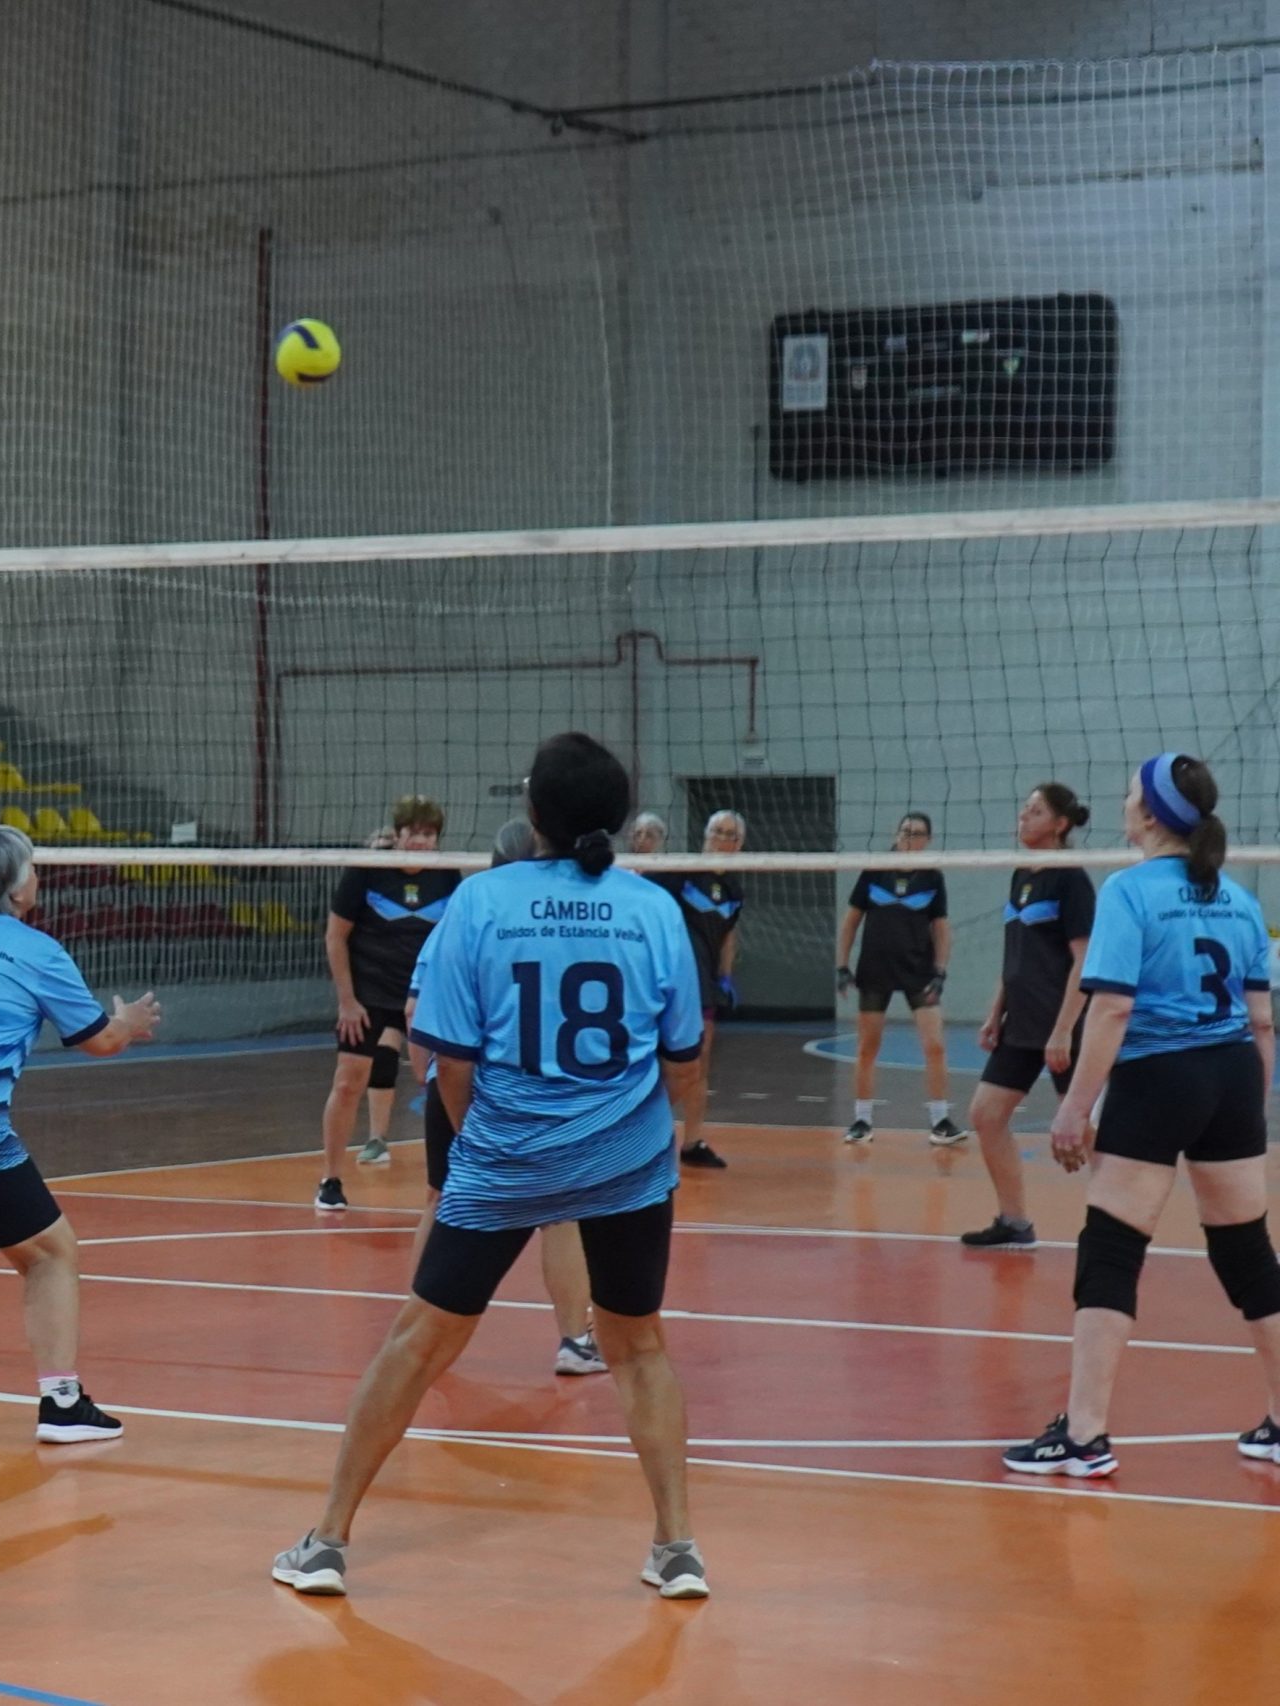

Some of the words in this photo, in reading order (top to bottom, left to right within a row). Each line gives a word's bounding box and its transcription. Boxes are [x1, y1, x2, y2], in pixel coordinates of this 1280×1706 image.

[531, 896, 612, 921] CÂMBIO
[497, 926, 537, 941] Unidos
[541, 925, 555, 937] de
[559, 926, 609, 938] Estância
[614, 928, 644, 943] Velha
[1194, 937, 1233, 1024] 3
[512, 961, 630, 1081] 18
[1035, 1444, 1066, 1460] FILA
